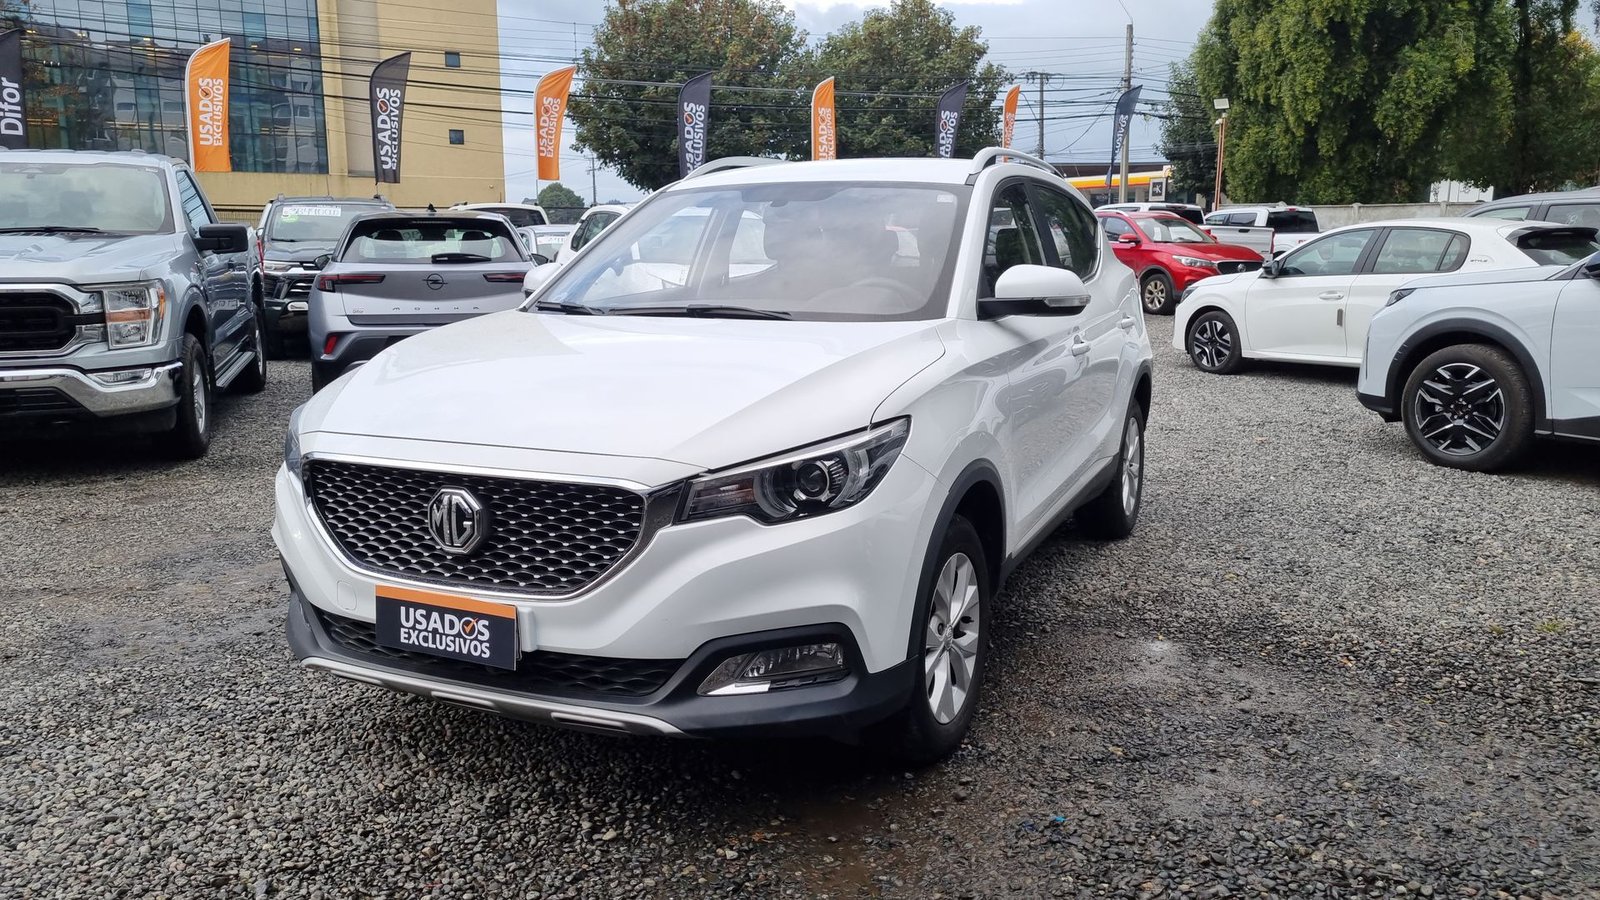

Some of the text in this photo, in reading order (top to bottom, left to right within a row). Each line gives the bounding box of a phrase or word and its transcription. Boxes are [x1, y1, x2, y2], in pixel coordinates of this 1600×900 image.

[0, 76, 23, 136] Difor
[199, 78, 213, 146] USADOS
[213, 78, 223, 146] EXCLUSIVOS
[376, 87, 392, 169] USADOS
[390, 88, 401, 170] EXCLUSIVOS
[540, 96, 554, 157] USADOS
[547, 97, 560, 158] EXCLUSIVOS
[693, 104, 705, 168] XCLUSIVOS
[940, 110, 950, 158] ADOS
[944, 111, 958, 158] LUSIVOS
[430, 494, 474, 547] MG
[400, 605, 490, 641] USADOS
[400, 627, 491, 659] EXCLUSIVOS
